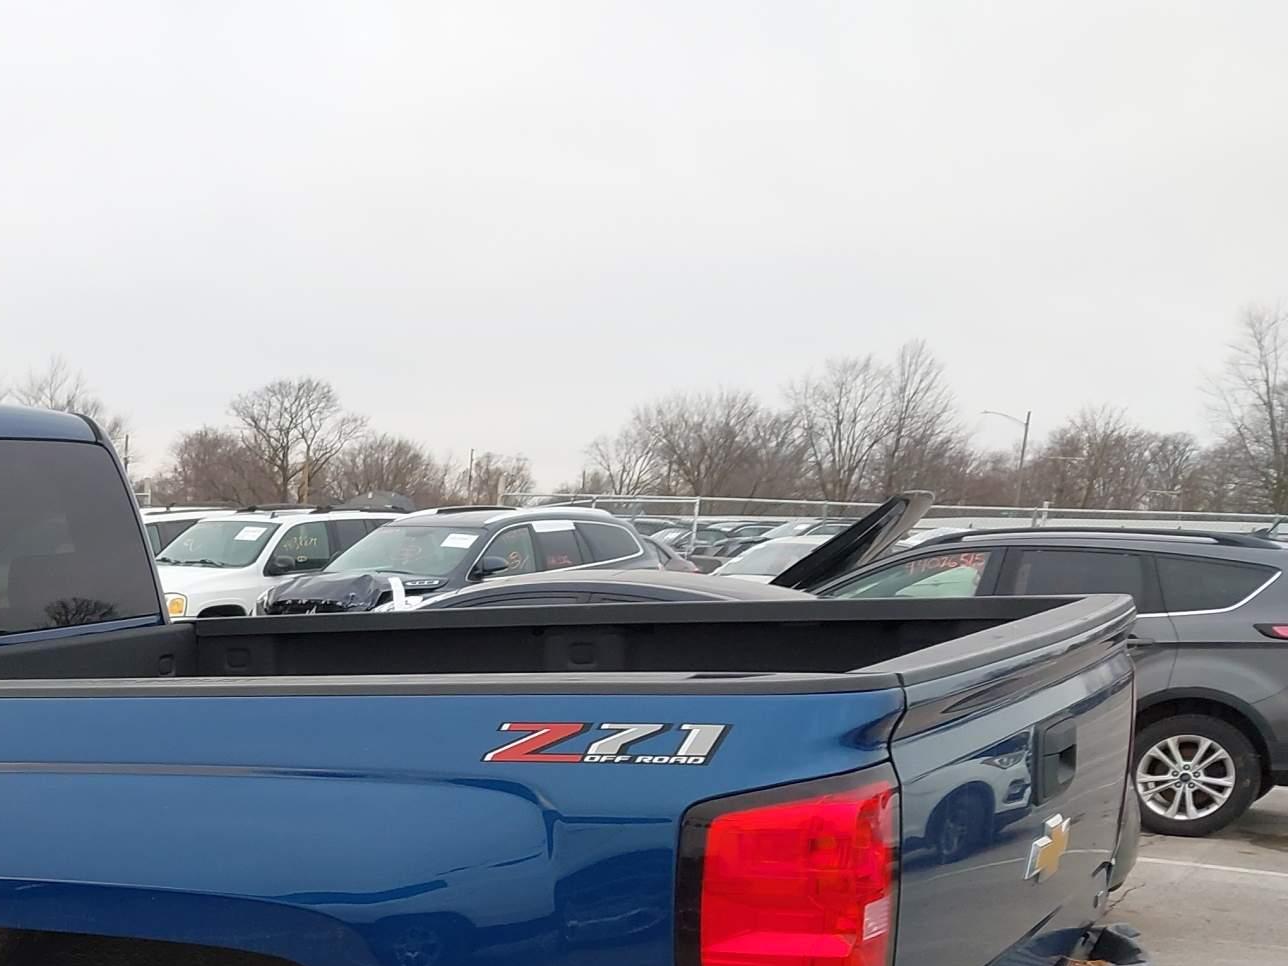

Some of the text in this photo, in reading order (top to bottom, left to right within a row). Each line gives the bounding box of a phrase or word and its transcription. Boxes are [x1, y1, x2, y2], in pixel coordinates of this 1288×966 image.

[481, 722, 731, 763] Z71
[583, 754, 706, 765] OFF ROAD
